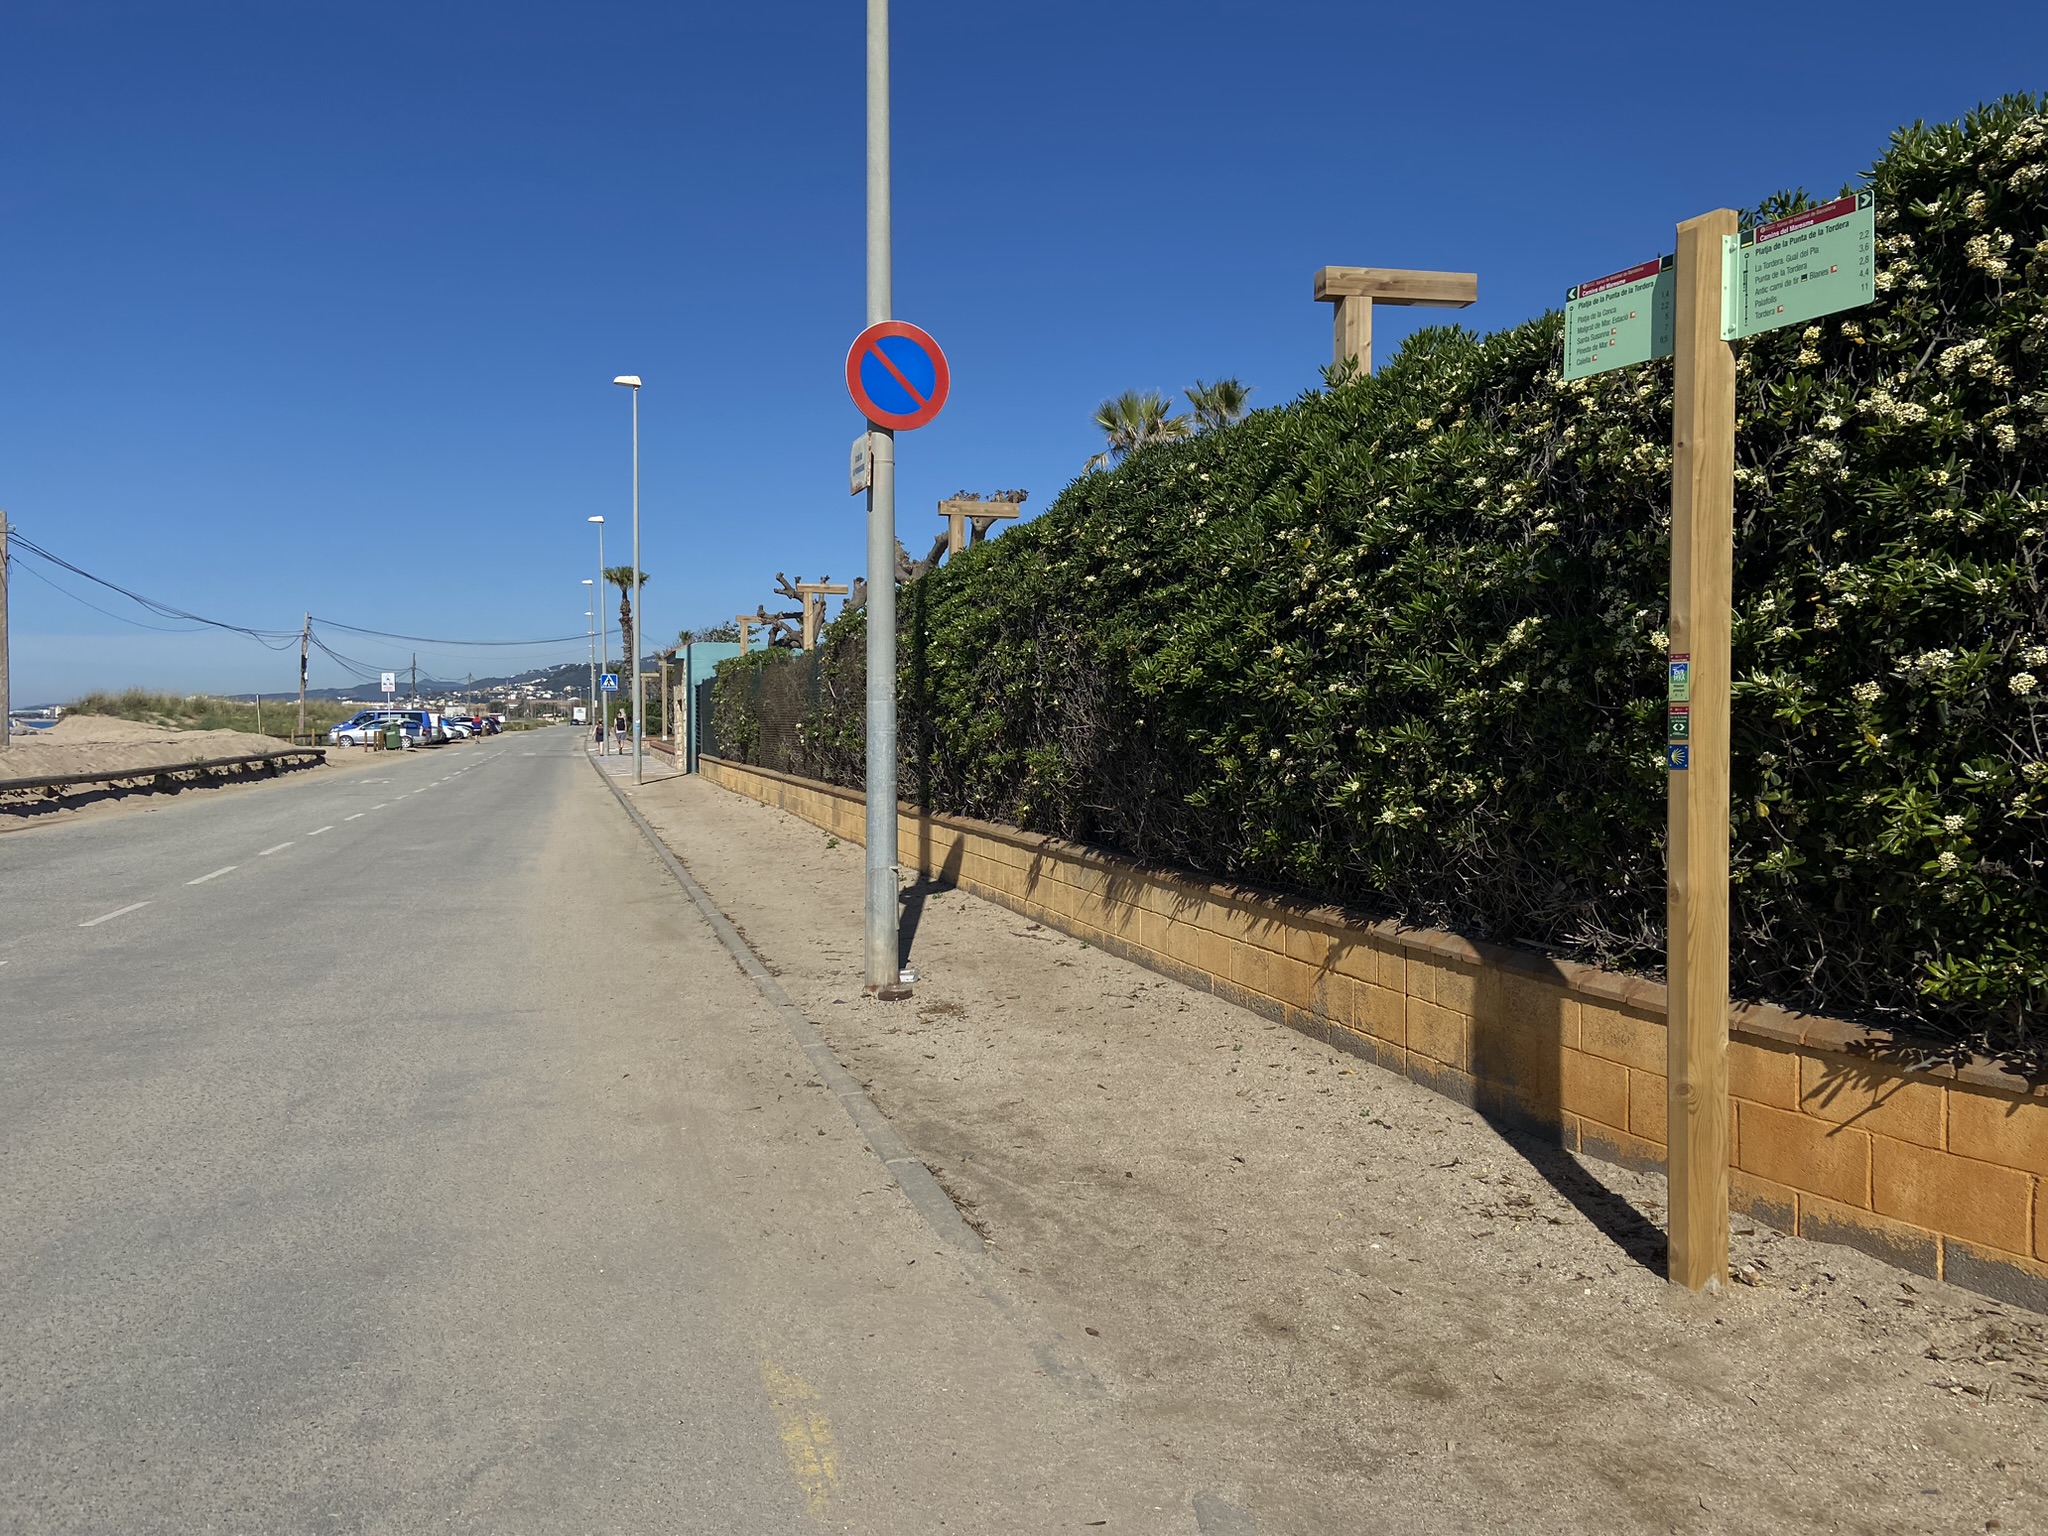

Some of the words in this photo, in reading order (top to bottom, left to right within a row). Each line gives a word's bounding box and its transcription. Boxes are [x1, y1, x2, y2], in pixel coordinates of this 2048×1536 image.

[1755, 244, 1772, 256] Platja
[1774, 241, 1781, 250] de
[1782, 238, 1788, 247] la
[1790, 234, 1807, 245] Punta
[1809, 230, 1816, 239] de
[1818, 227, 1824, 236] la
[1826, 220, 1849, 233] Tordera
[1760, 230, 1779, 242] Camins
[1780, 226, 1788, 235] del
[1859, 230, 1869, 240] 2,2
[1859, 243, 1869, 253] 3,6
[1755, 264, 1762, 272] La
[1786, 253, 1798, 262] Gual
[1800, 249, 1808, 258] del
[1810, 247, 1819, 255] Pla
[1859, 256, 1869, 266] 2,8
[1755, 274, 1770, 284] Punta
[1772, 271, 1778, 279] de
[1780, 268, 1785, 276] la
[1786, 262, 1807, 274] Tordera
[1784, 279, 1792, 287] de
[1809, 268, 1828, 280] Blanes
[1859, 268, 1869, 278] 4,4
[1861, 282, 1868, 291] 11
[1578, 300, 1592, 310] Platja
[1606, 292, 1620, 301] Punta
[1635, 281, 1654, 292] Tordera
[1577, 315, 1590, 323] Platja
[1602, 307, 1616, 316] Conca
[1755, 308, 1775, 319] Tordera
[1577, 324, 1594, 334] Malgrat
[1577, 336, 1590, 345] Santa
[1590, 330, 1610, 341] Susanna
[1577, 346, 1591, 355] Pineda
